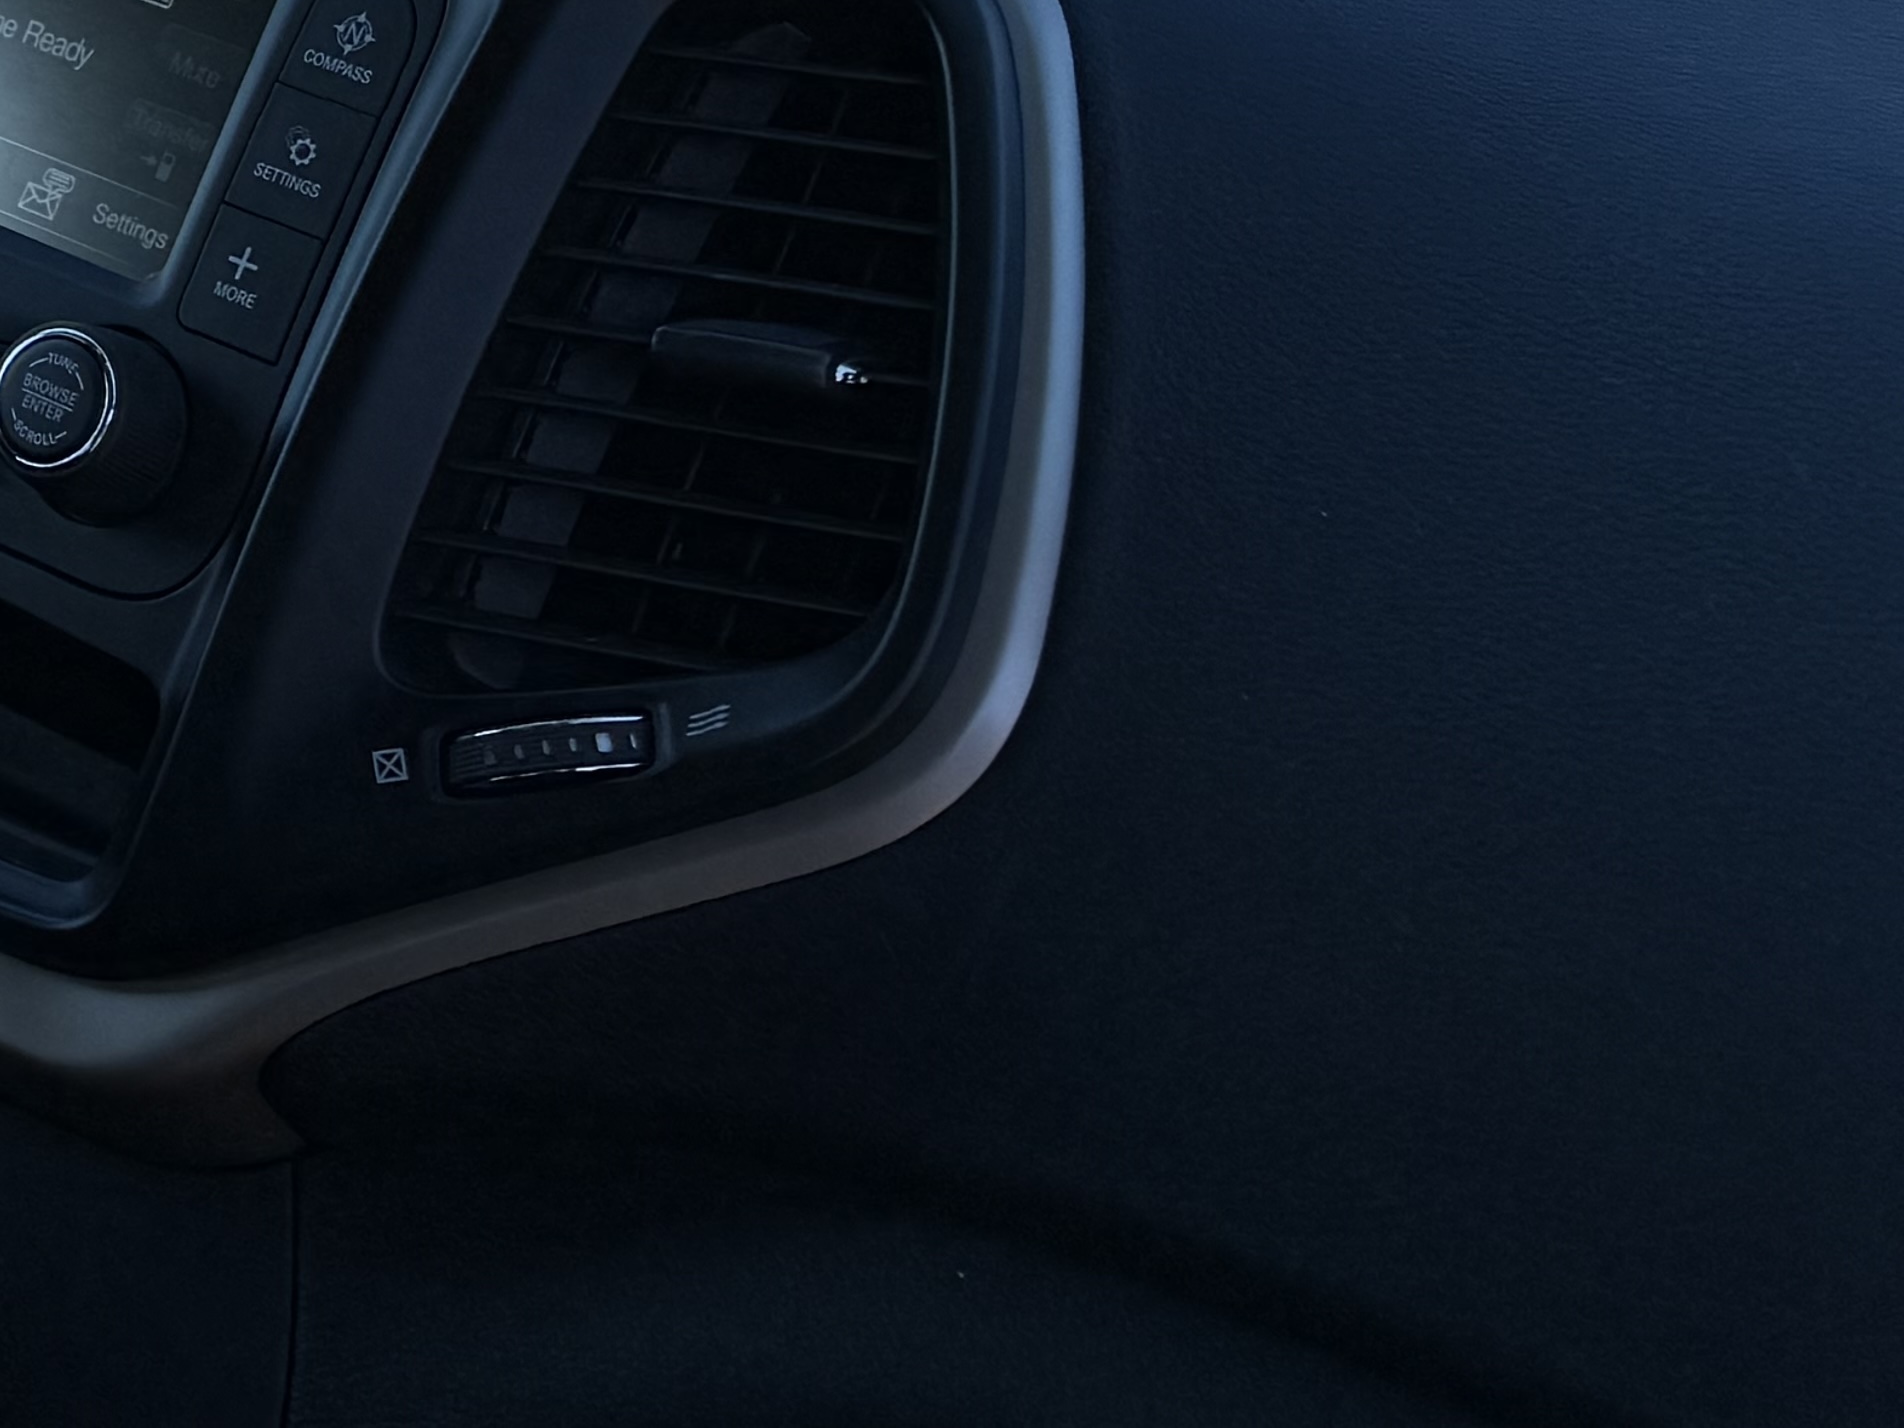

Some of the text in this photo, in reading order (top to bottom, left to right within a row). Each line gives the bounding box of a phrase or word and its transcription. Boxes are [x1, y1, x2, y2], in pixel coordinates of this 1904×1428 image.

[21, 19, 95, 72] Ready
[303, 48, 374, 86] COMPASS
[253, 161, 322, 199] SETTINGS
[92, 201, 170, 251] Settings
[212, 279, 258, 311] MORE
[47, 351, 80, 375] TUNE
[23, 372, 80, 407] BROWSE
[22, 394, 65, 424] ENTER
[13, 418, 58, 447] SCROLL
